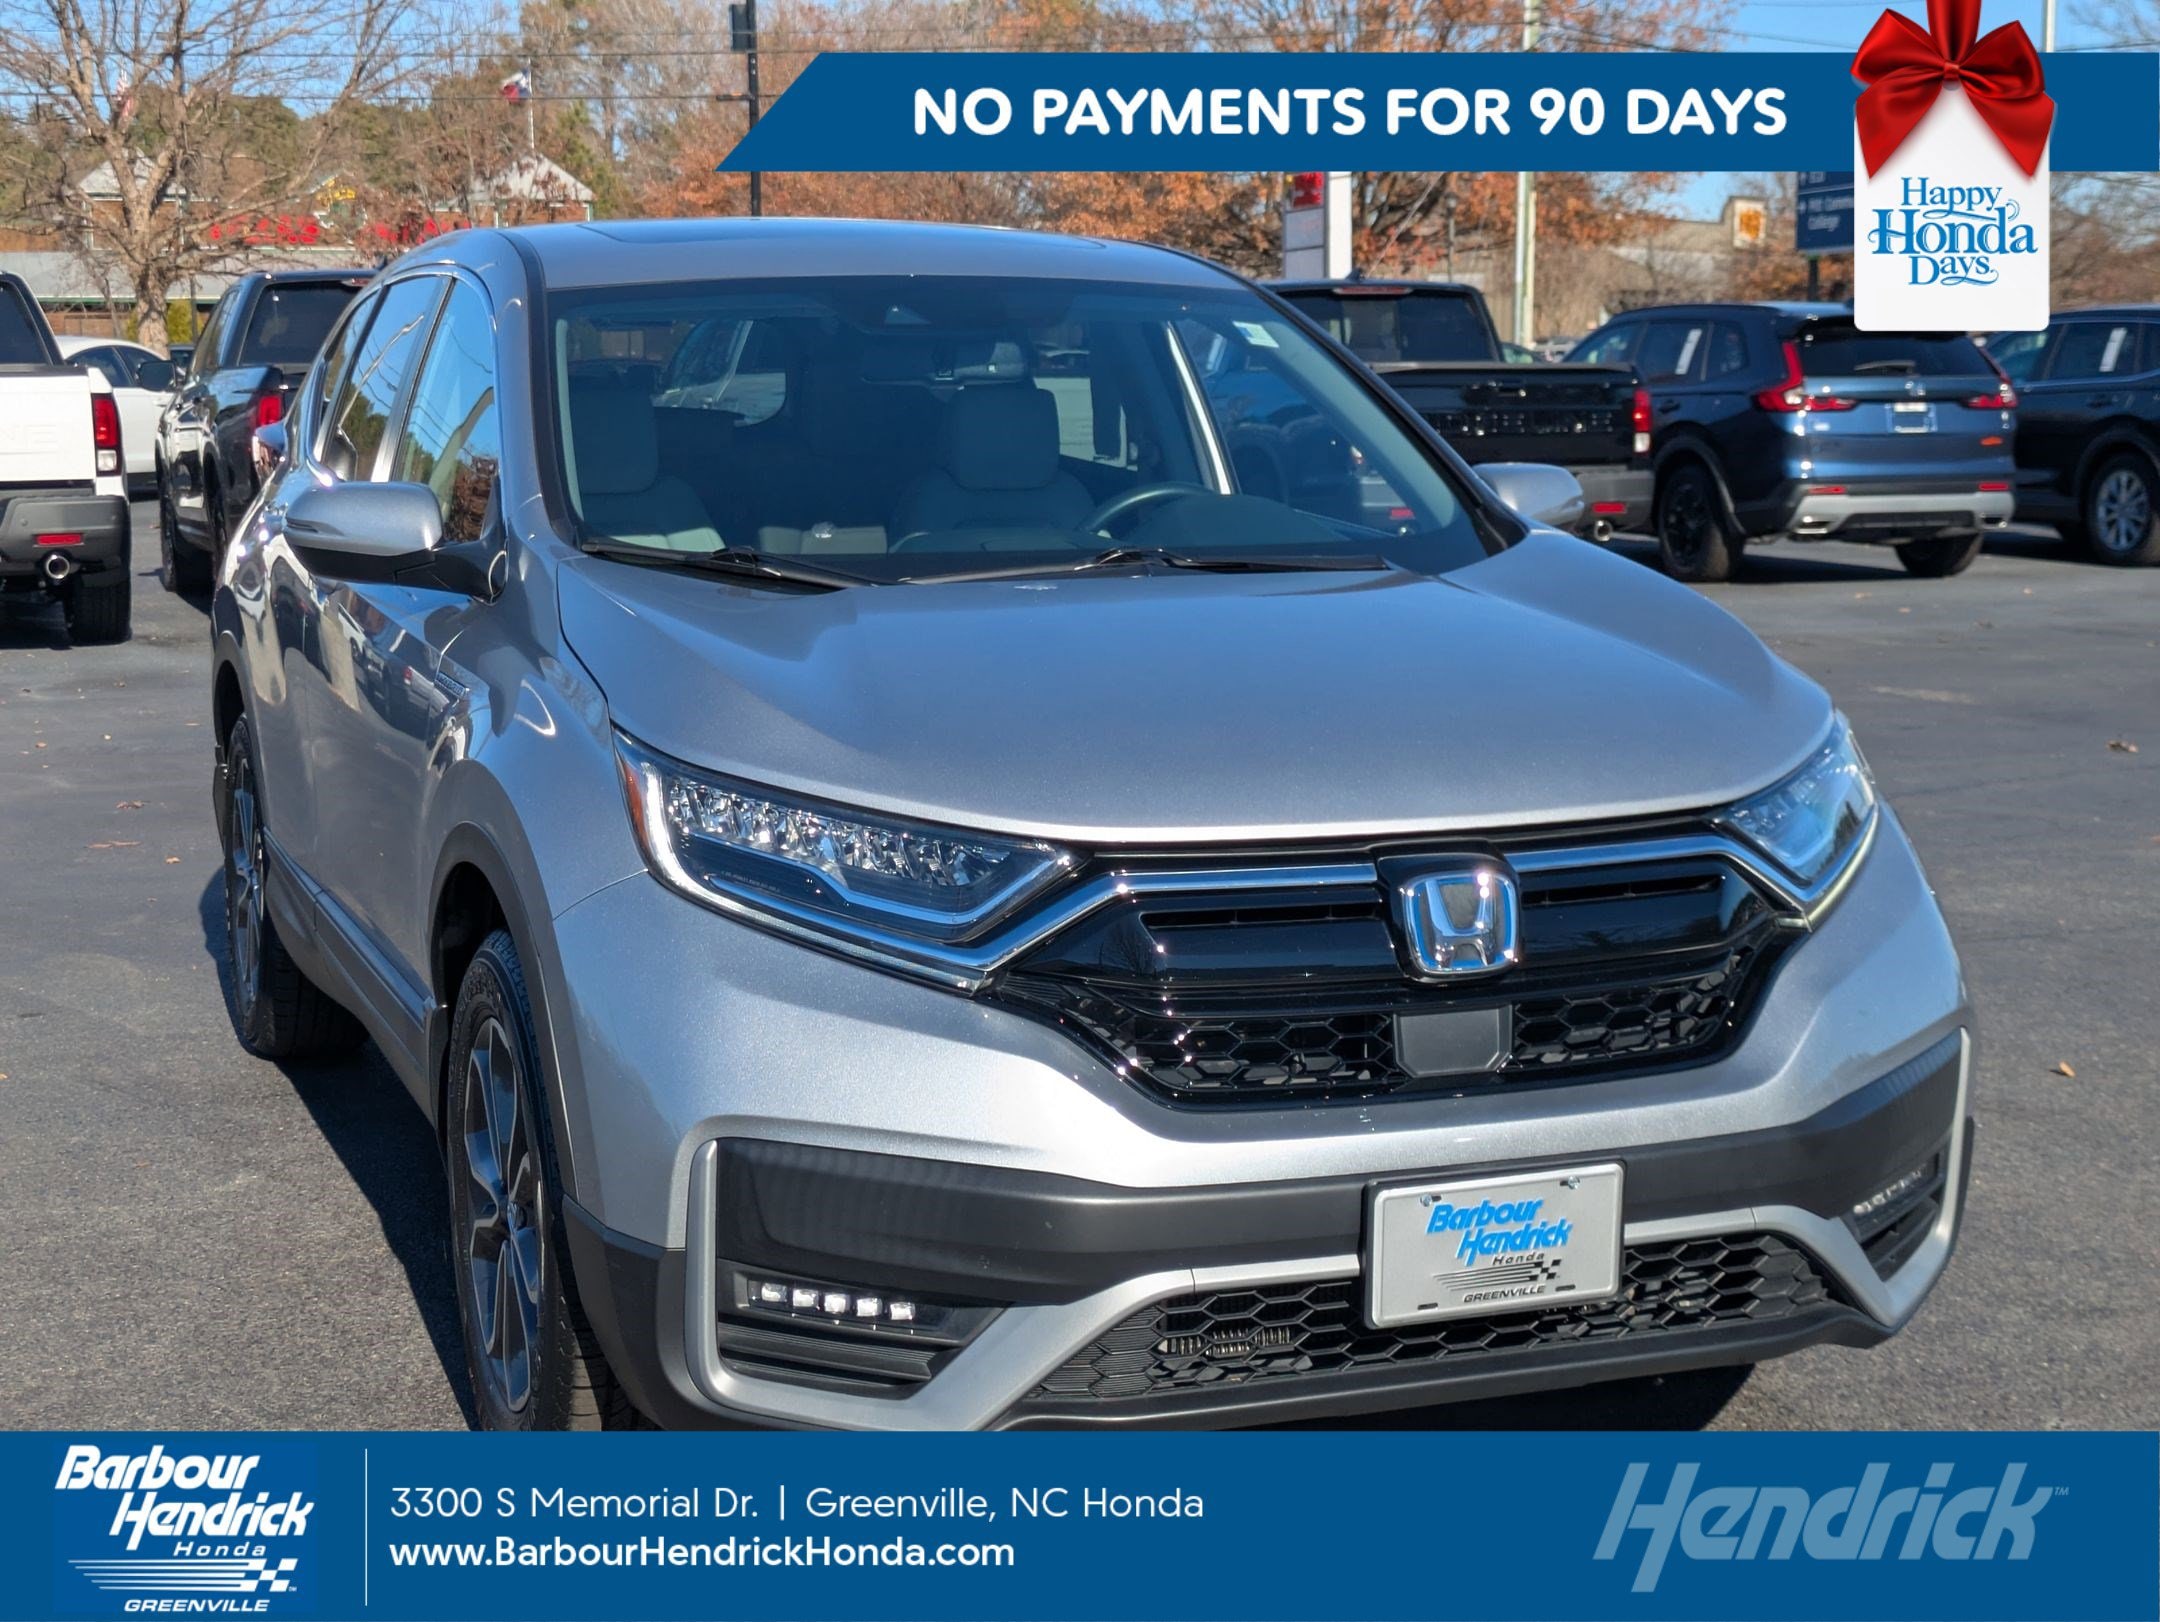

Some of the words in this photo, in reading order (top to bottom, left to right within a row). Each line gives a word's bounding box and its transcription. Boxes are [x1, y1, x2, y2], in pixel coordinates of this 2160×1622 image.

[1426, 1199, 1543, 1234] Barbour
[1456, 1217, 1573, 1267] Hendrick
[1493, 1252, 1544, 1266] Honda
[1463, 1285, 1546, 1303] GREENVILLE
